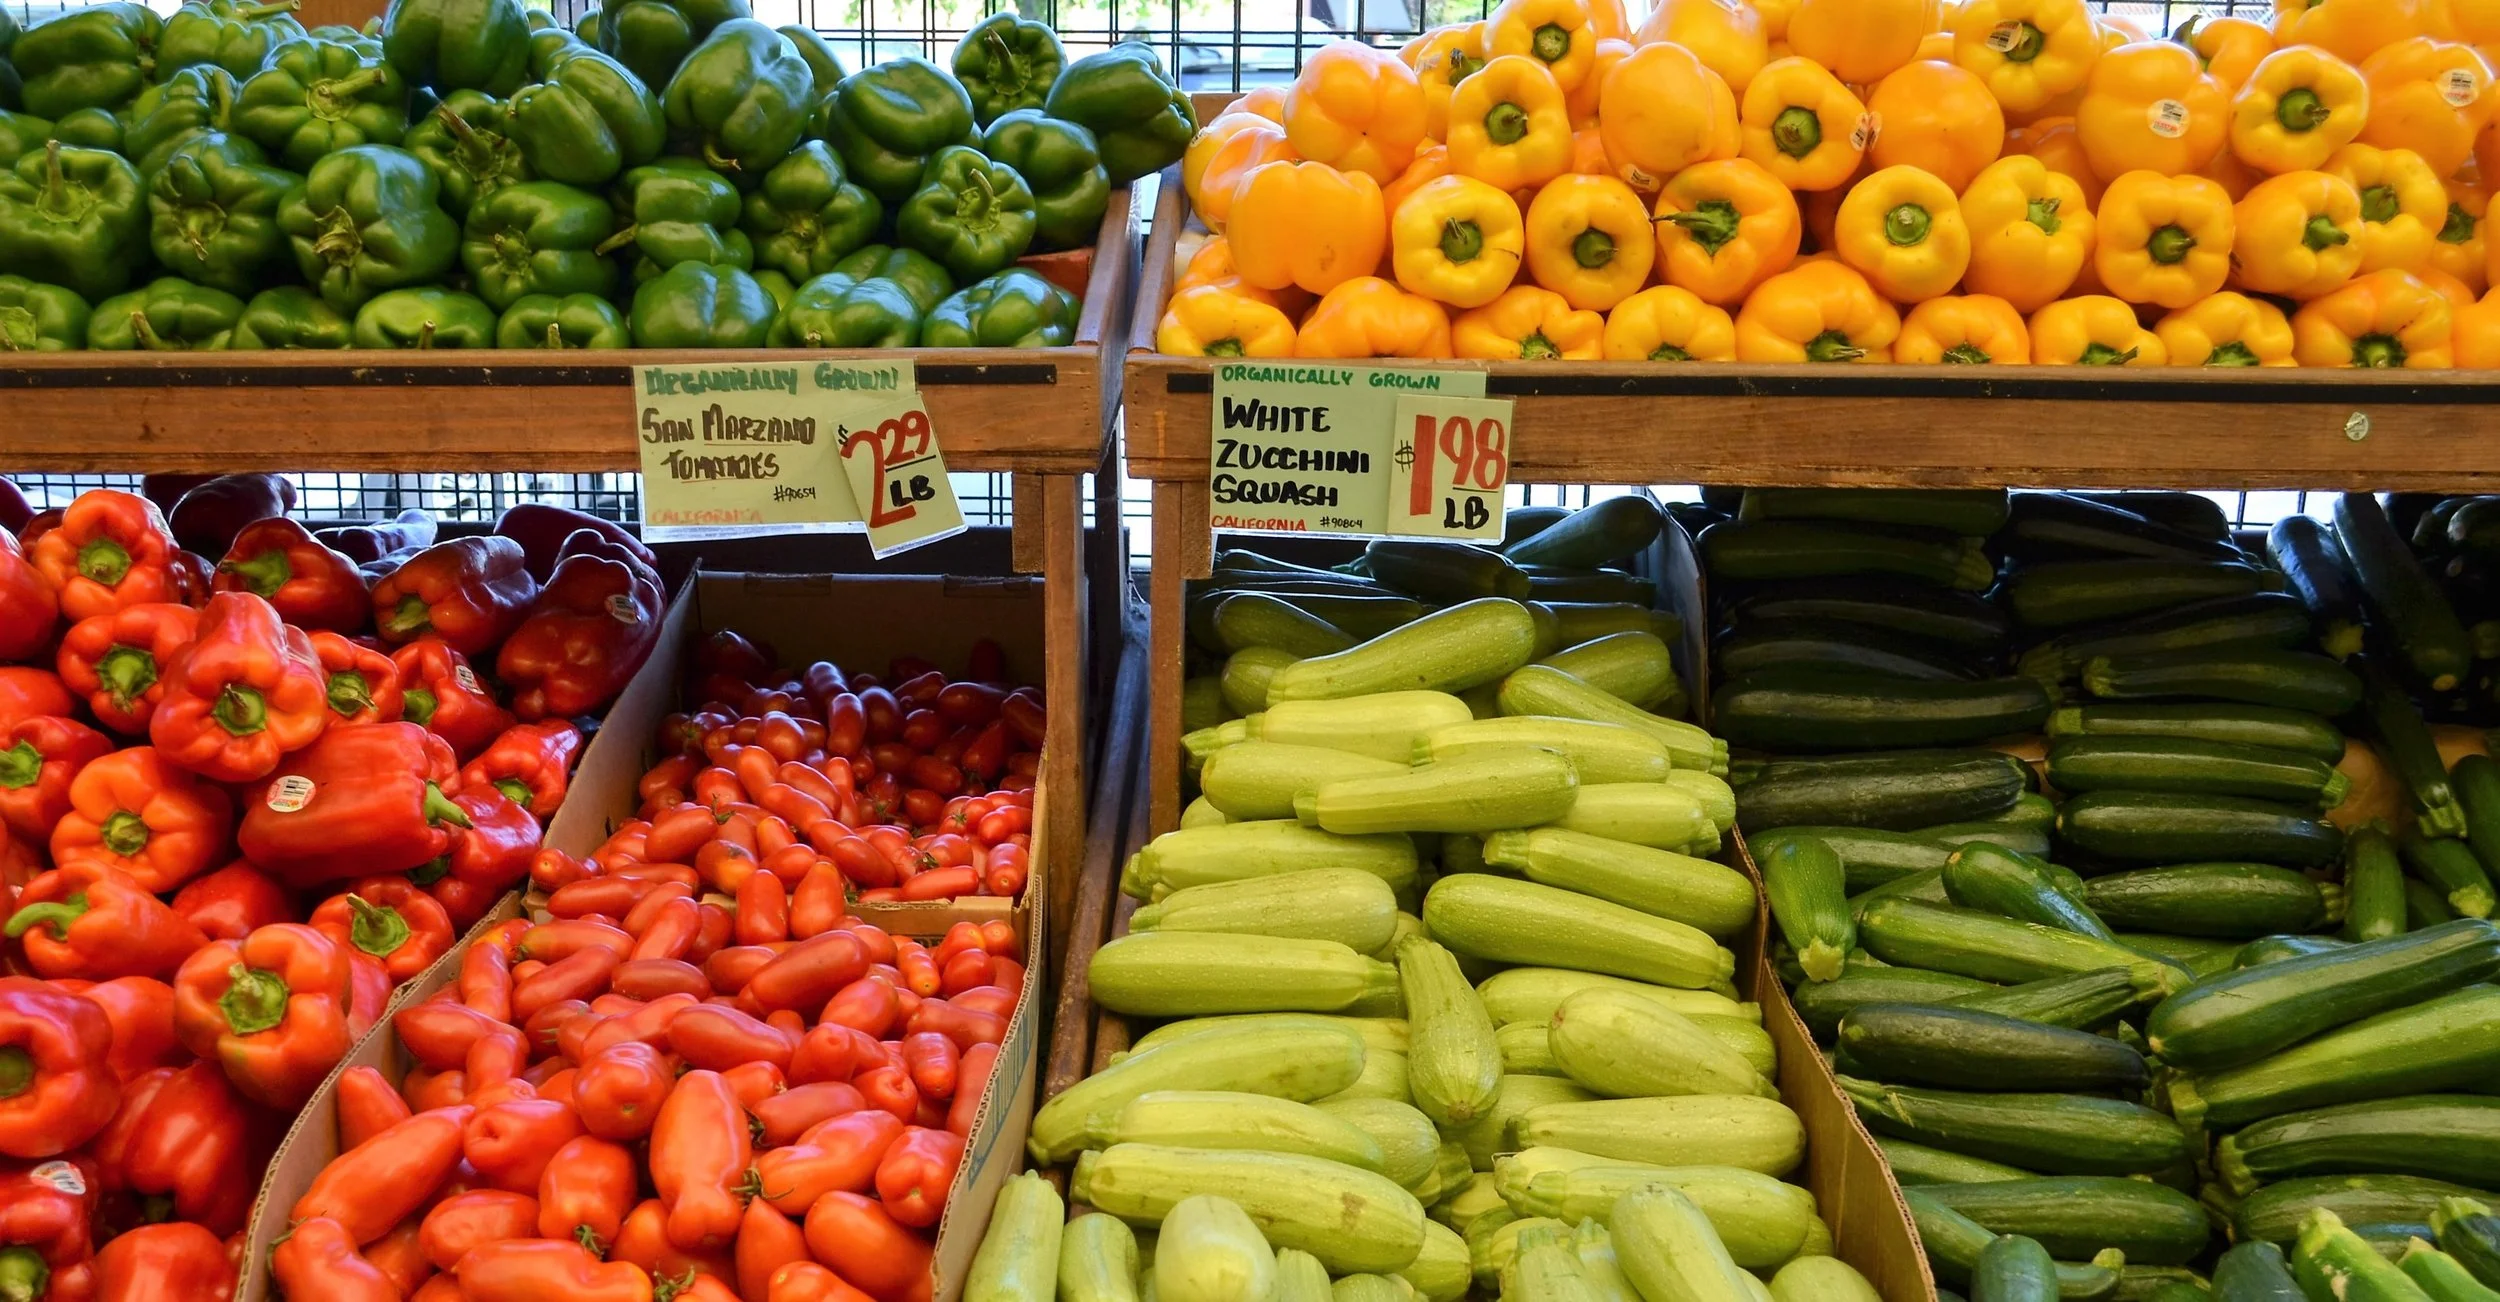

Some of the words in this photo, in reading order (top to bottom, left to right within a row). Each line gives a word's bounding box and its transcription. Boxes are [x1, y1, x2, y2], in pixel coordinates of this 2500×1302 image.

[1222, 365, 1353, 387] ORGANICALLY
[1369, 373, 1440, 390] GROWN
[641, 407, 694, 444] SAN
[702, 403, 816, 443] MARZANO
[1222, 396, 1331, 433] WHITE
[660, 449, 780, 480] TOMATOES
[1216, 439, 1370, 473] ZUCCHINI
[773, 484, 816, 502] #90654
[890, 475, 935, 507] LB
[1212, 474, 1338, 506] SQUASH
[1211, 515, 1307, 531] CALIFORNIA
[1320, 516, 1363, 529] #90804
[1444, 496, 1489, 529] LB
